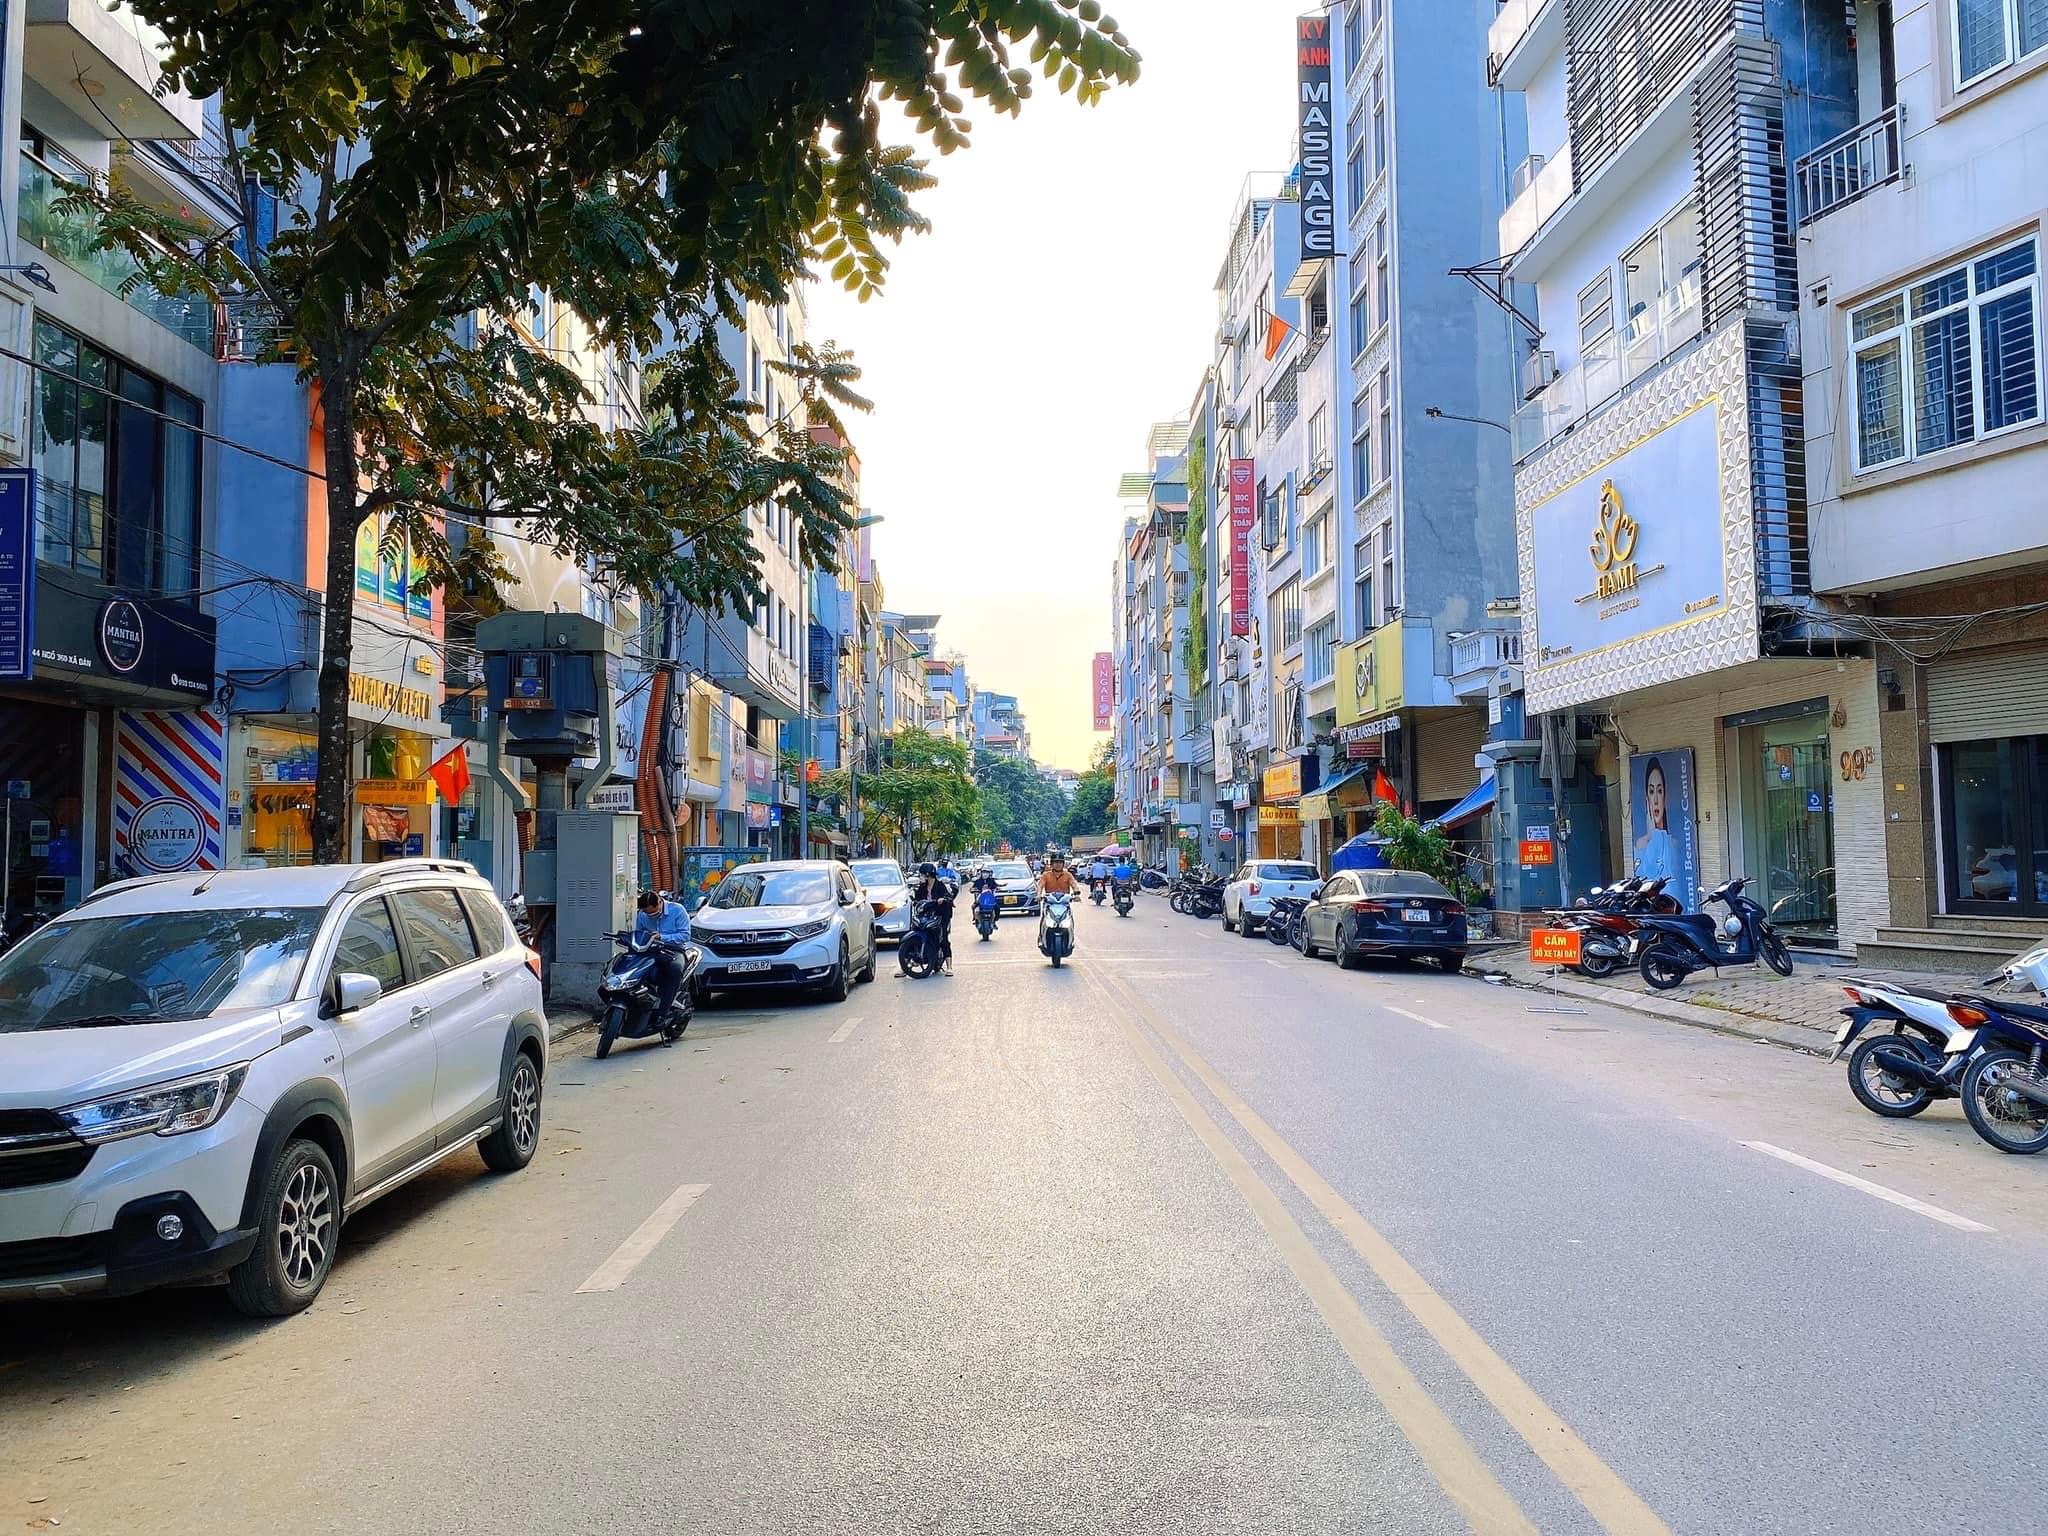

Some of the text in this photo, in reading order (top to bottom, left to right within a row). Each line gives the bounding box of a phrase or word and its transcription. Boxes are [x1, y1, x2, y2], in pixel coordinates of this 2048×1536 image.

[1300, 47, 1329, 65] ANH
[1302, 82, 1332, 250] MASSAGE
[1597, 563, 1638, 601] HAMI
[107, 625, 140, 643] MANTRA
[32, 648, 40, 657] 44
[1680, 758, 1689, 811] Center
[139, 828, 196, 840] MANTRA
[1683, 816, 1693, 870] Beauty
[1544, 934, 1567, 947] CẤM
[1544, 949, 1553, 958] XE
